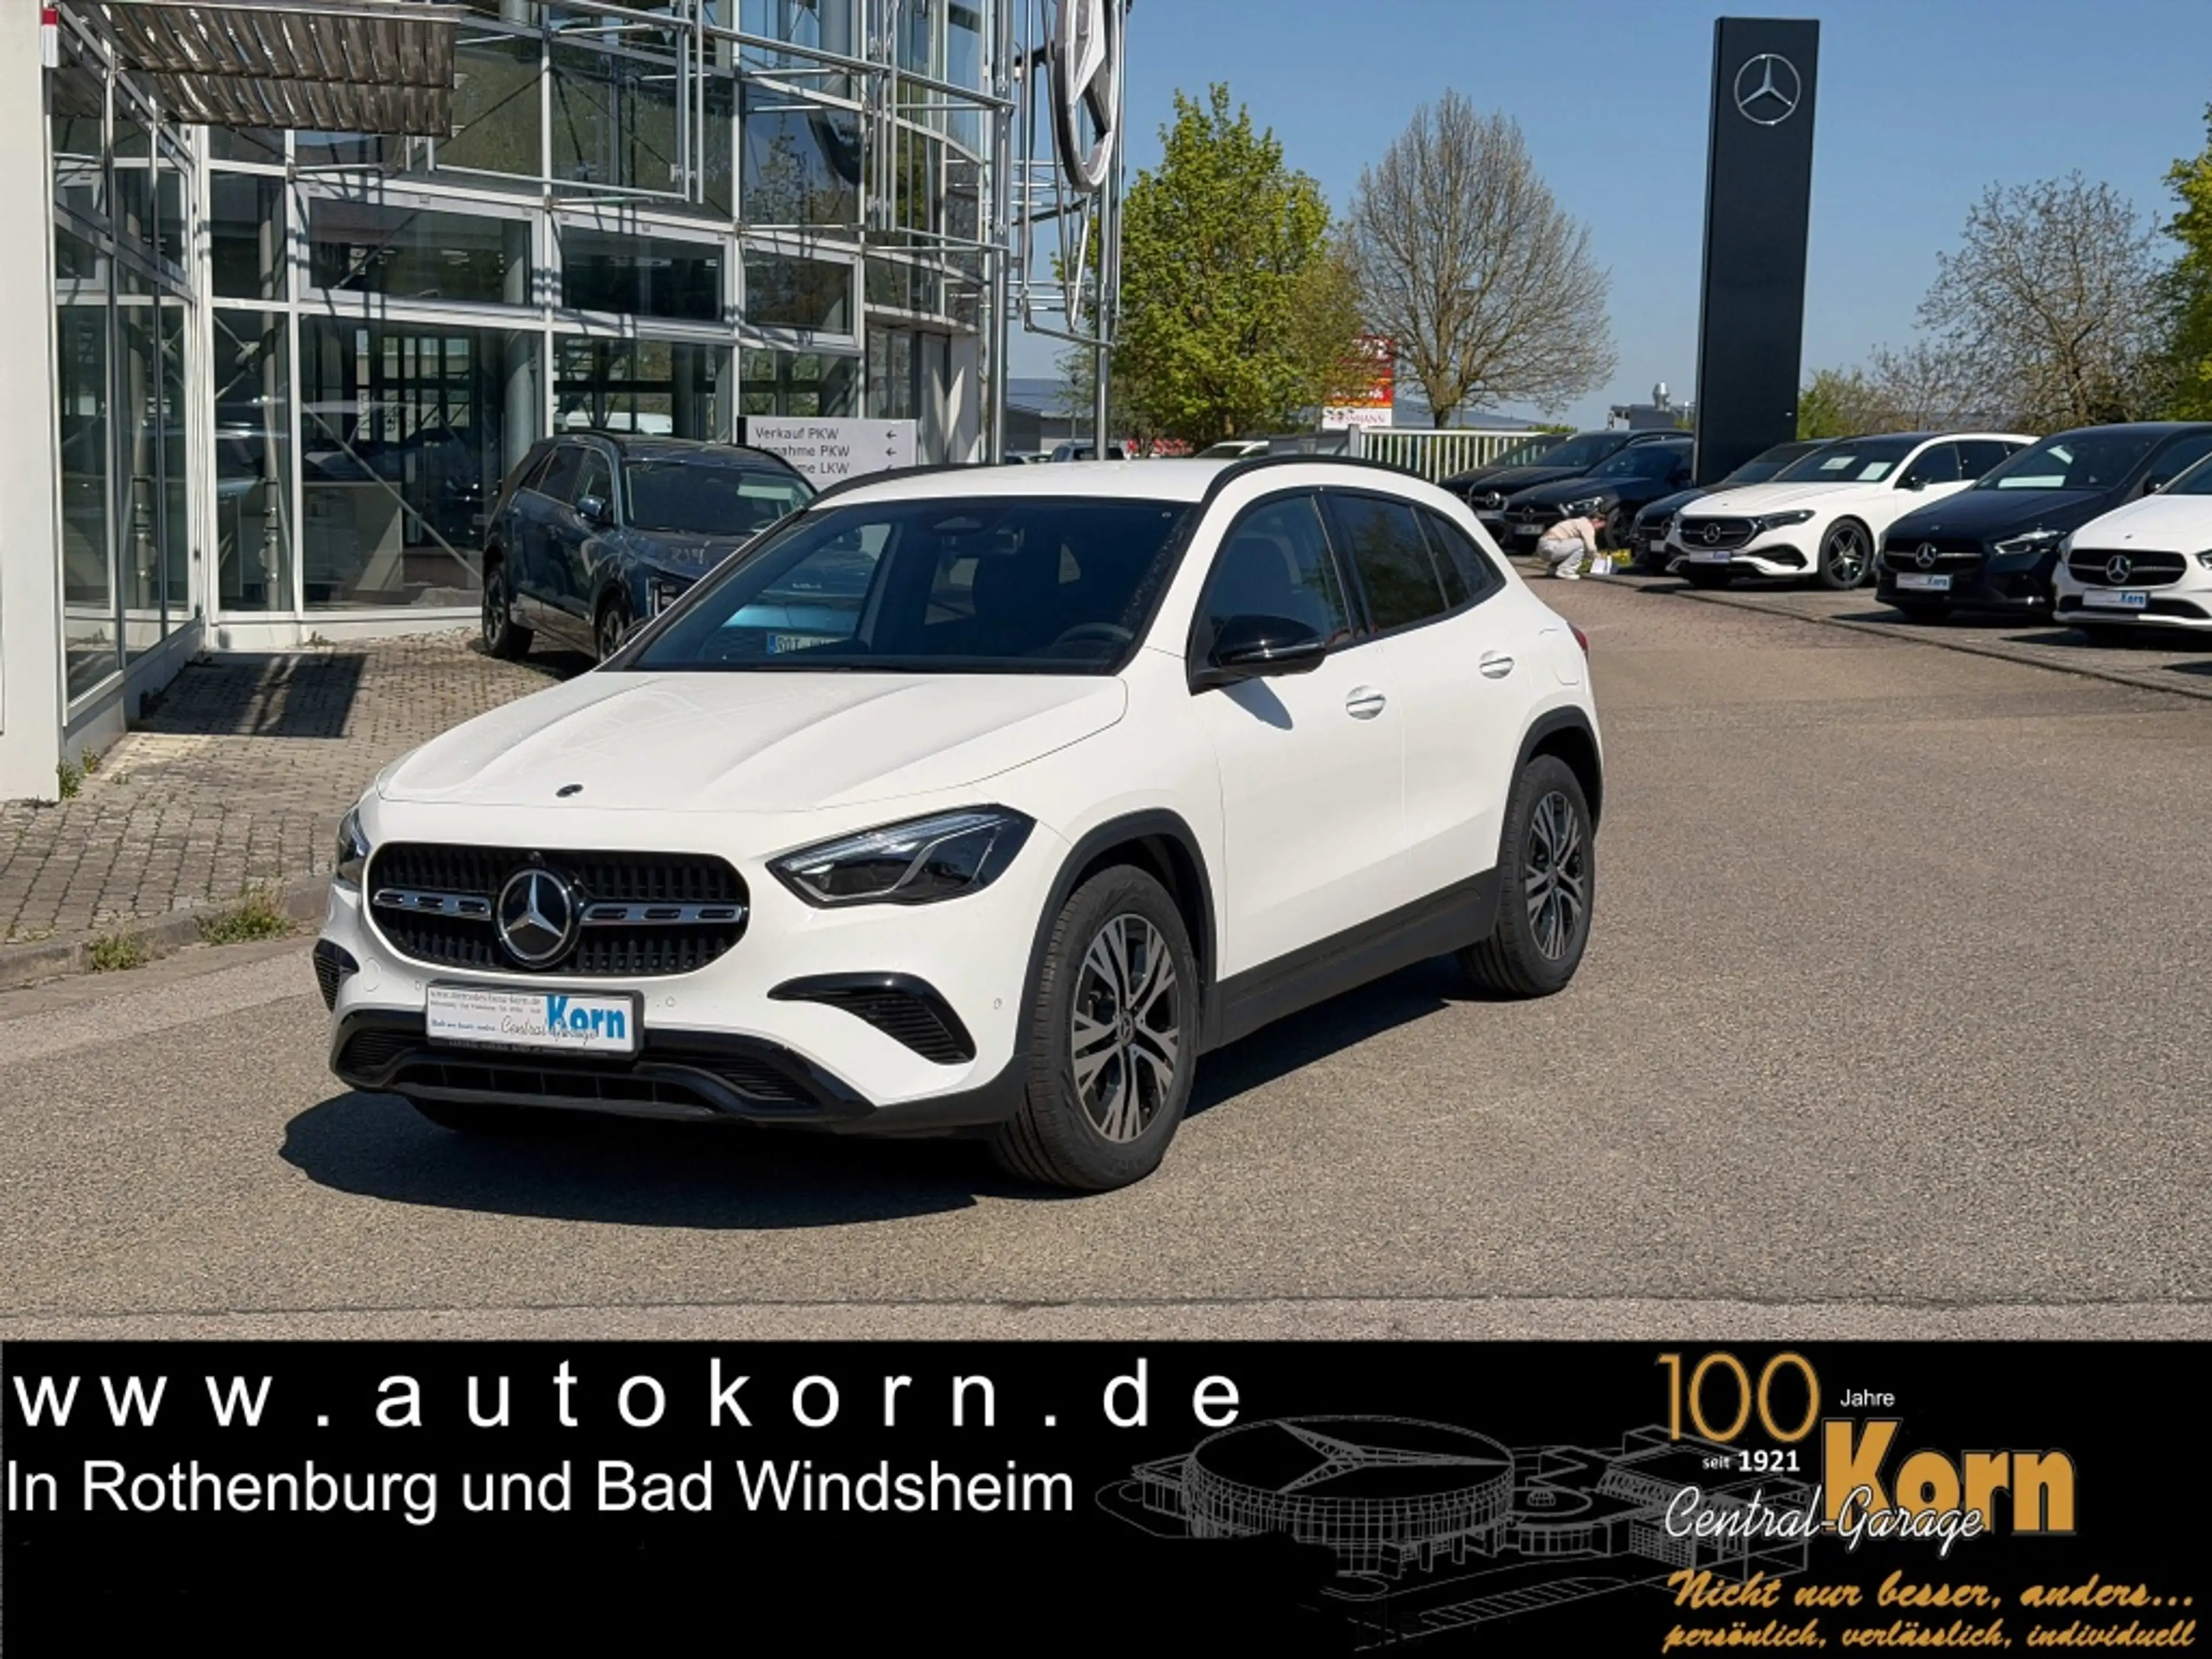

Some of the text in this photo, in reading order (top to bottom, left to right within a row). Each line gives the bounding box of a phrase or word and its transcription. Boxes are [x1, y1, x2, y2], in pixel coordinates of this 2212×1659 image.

[755, 427, 839, 440] Verkauf PKW
[820, 445, 850, 457] PKW
[820, 462, 850, 474] LKW
[546, 994, 626, 1039] Korn
